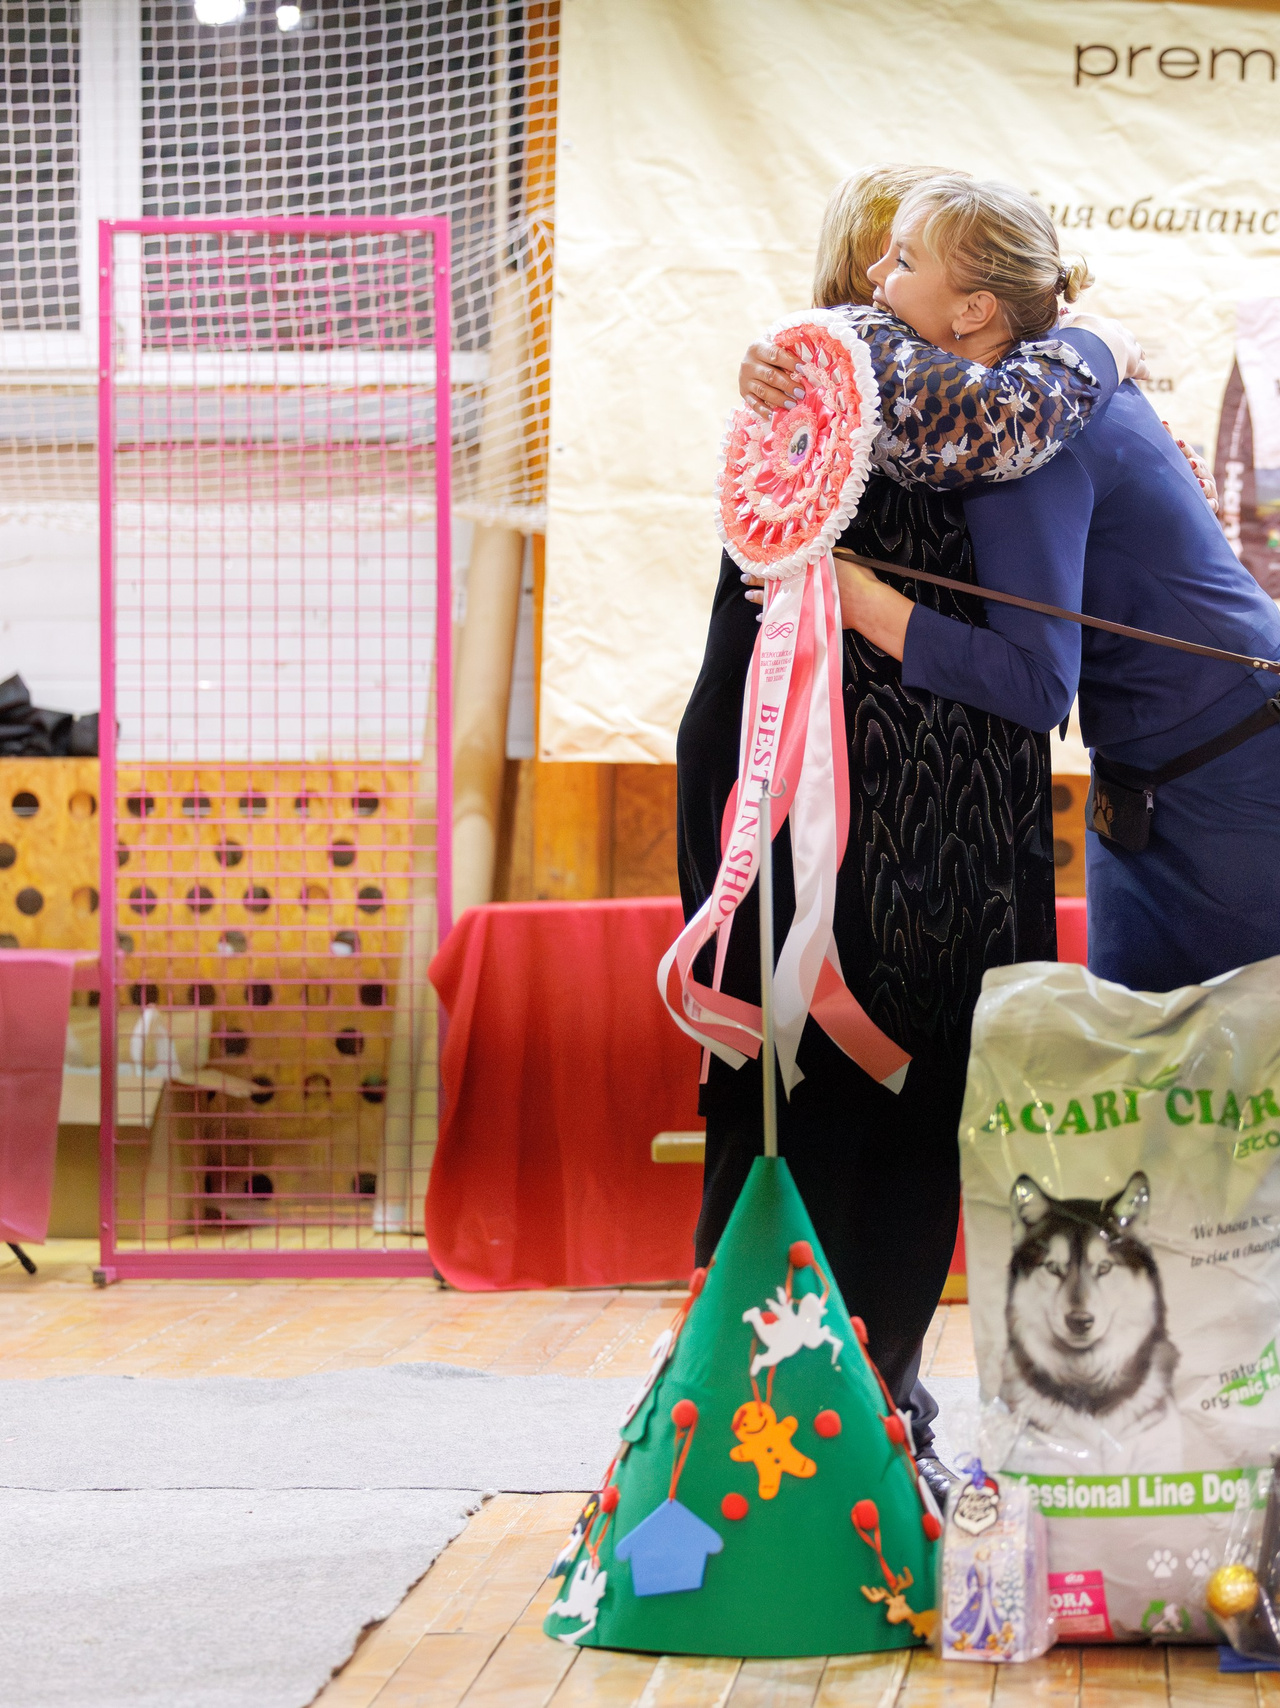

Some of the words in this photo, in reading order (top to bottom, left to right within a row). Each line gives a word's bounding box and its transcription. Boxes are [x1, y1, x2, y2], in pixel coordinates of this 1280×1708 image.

[750, 703, 781, 785] BEST
[735, 800, 761, 842] IN
[713, 844, 754, 928] SHO
[981, 1088, 1143, 1136] ACARI
[1219, 1351, 1276, 1385] natural
[1200, 1380, 1265, 1412] organic
[1137, 1475, 1195, 1509] Line
[1202, 1473, 1250, 1510] Dog
[1049, 1590, 1094, 1610] ORA
